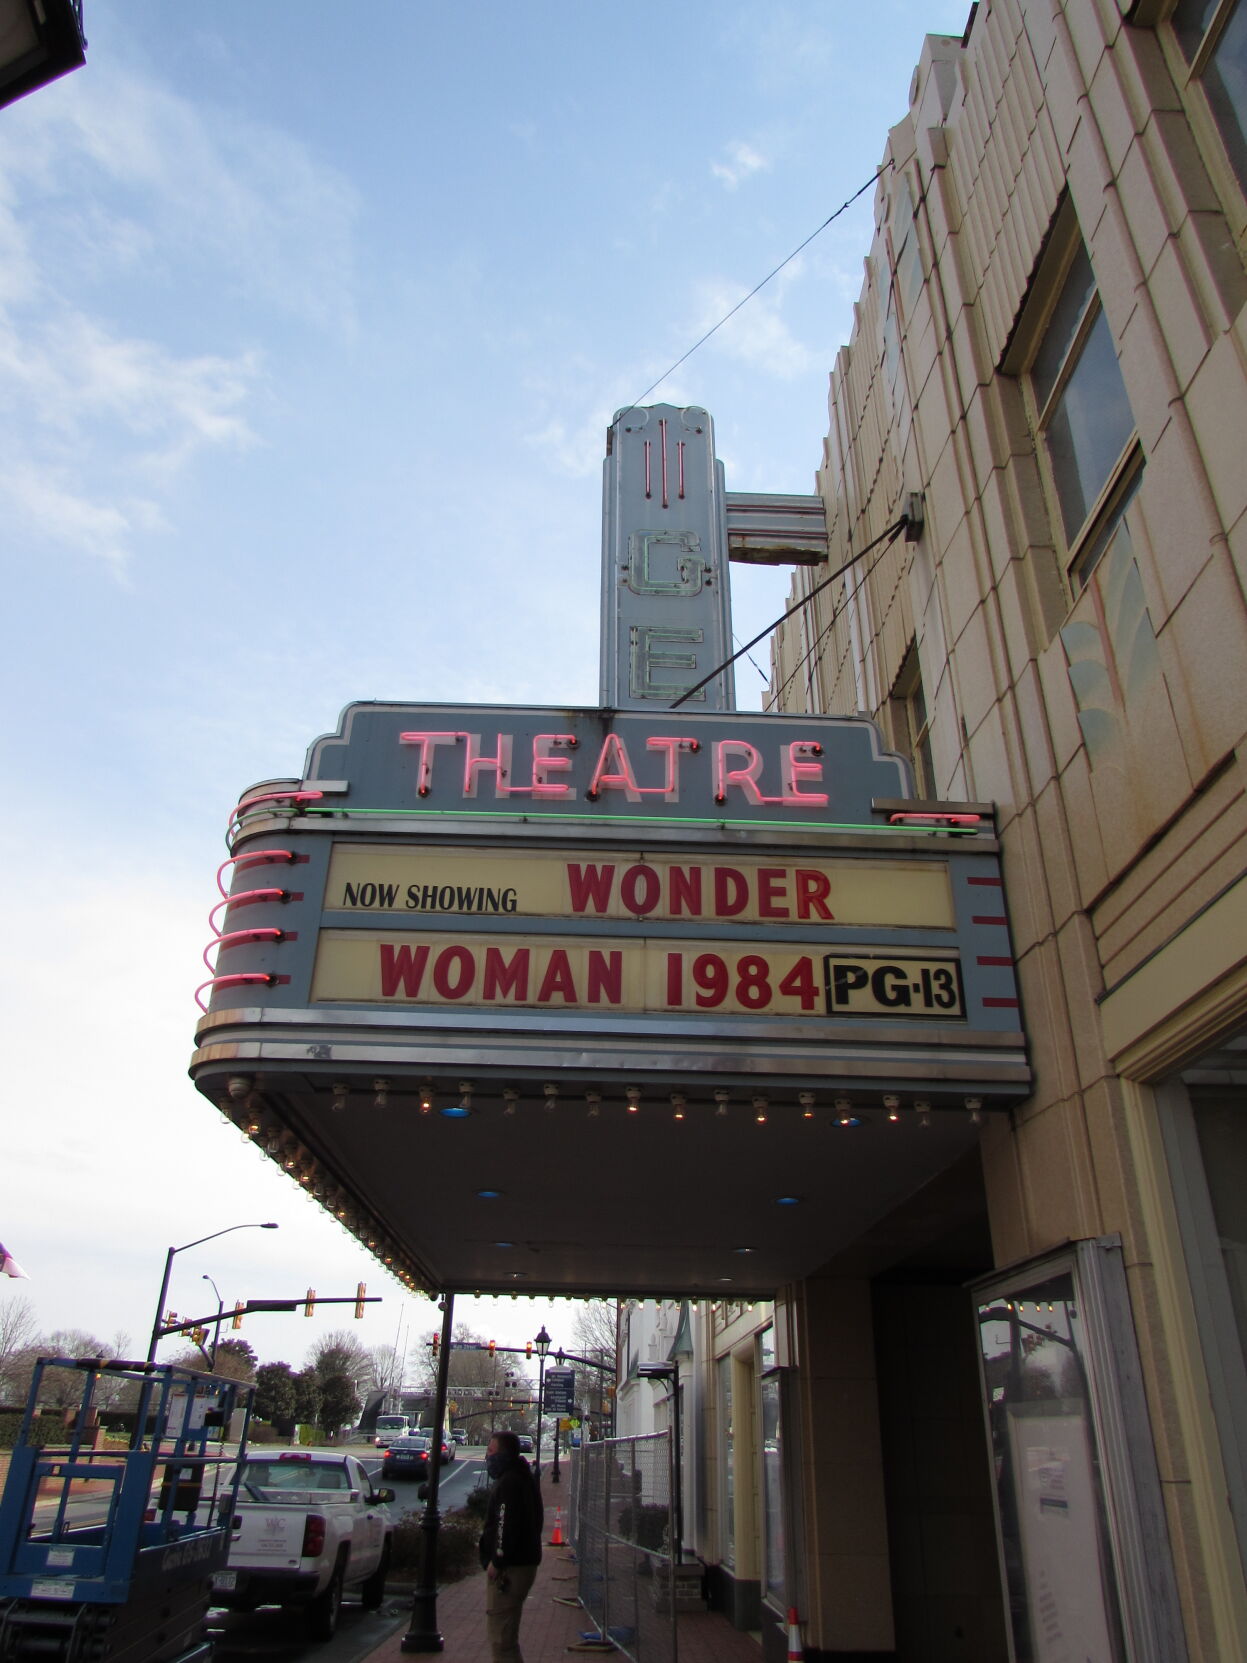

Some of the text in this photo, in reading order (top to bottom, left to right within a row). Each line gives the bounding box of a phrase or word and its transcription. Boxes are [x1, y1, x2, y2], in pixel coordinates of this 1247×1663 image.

[399, 733, 829, 808] THEATRE
[343, 882, 518, 913] NOW SHOWING
[566, 863, 836, 920] WONDER
[379, 943, 820, 1010] WOMAN 1984
